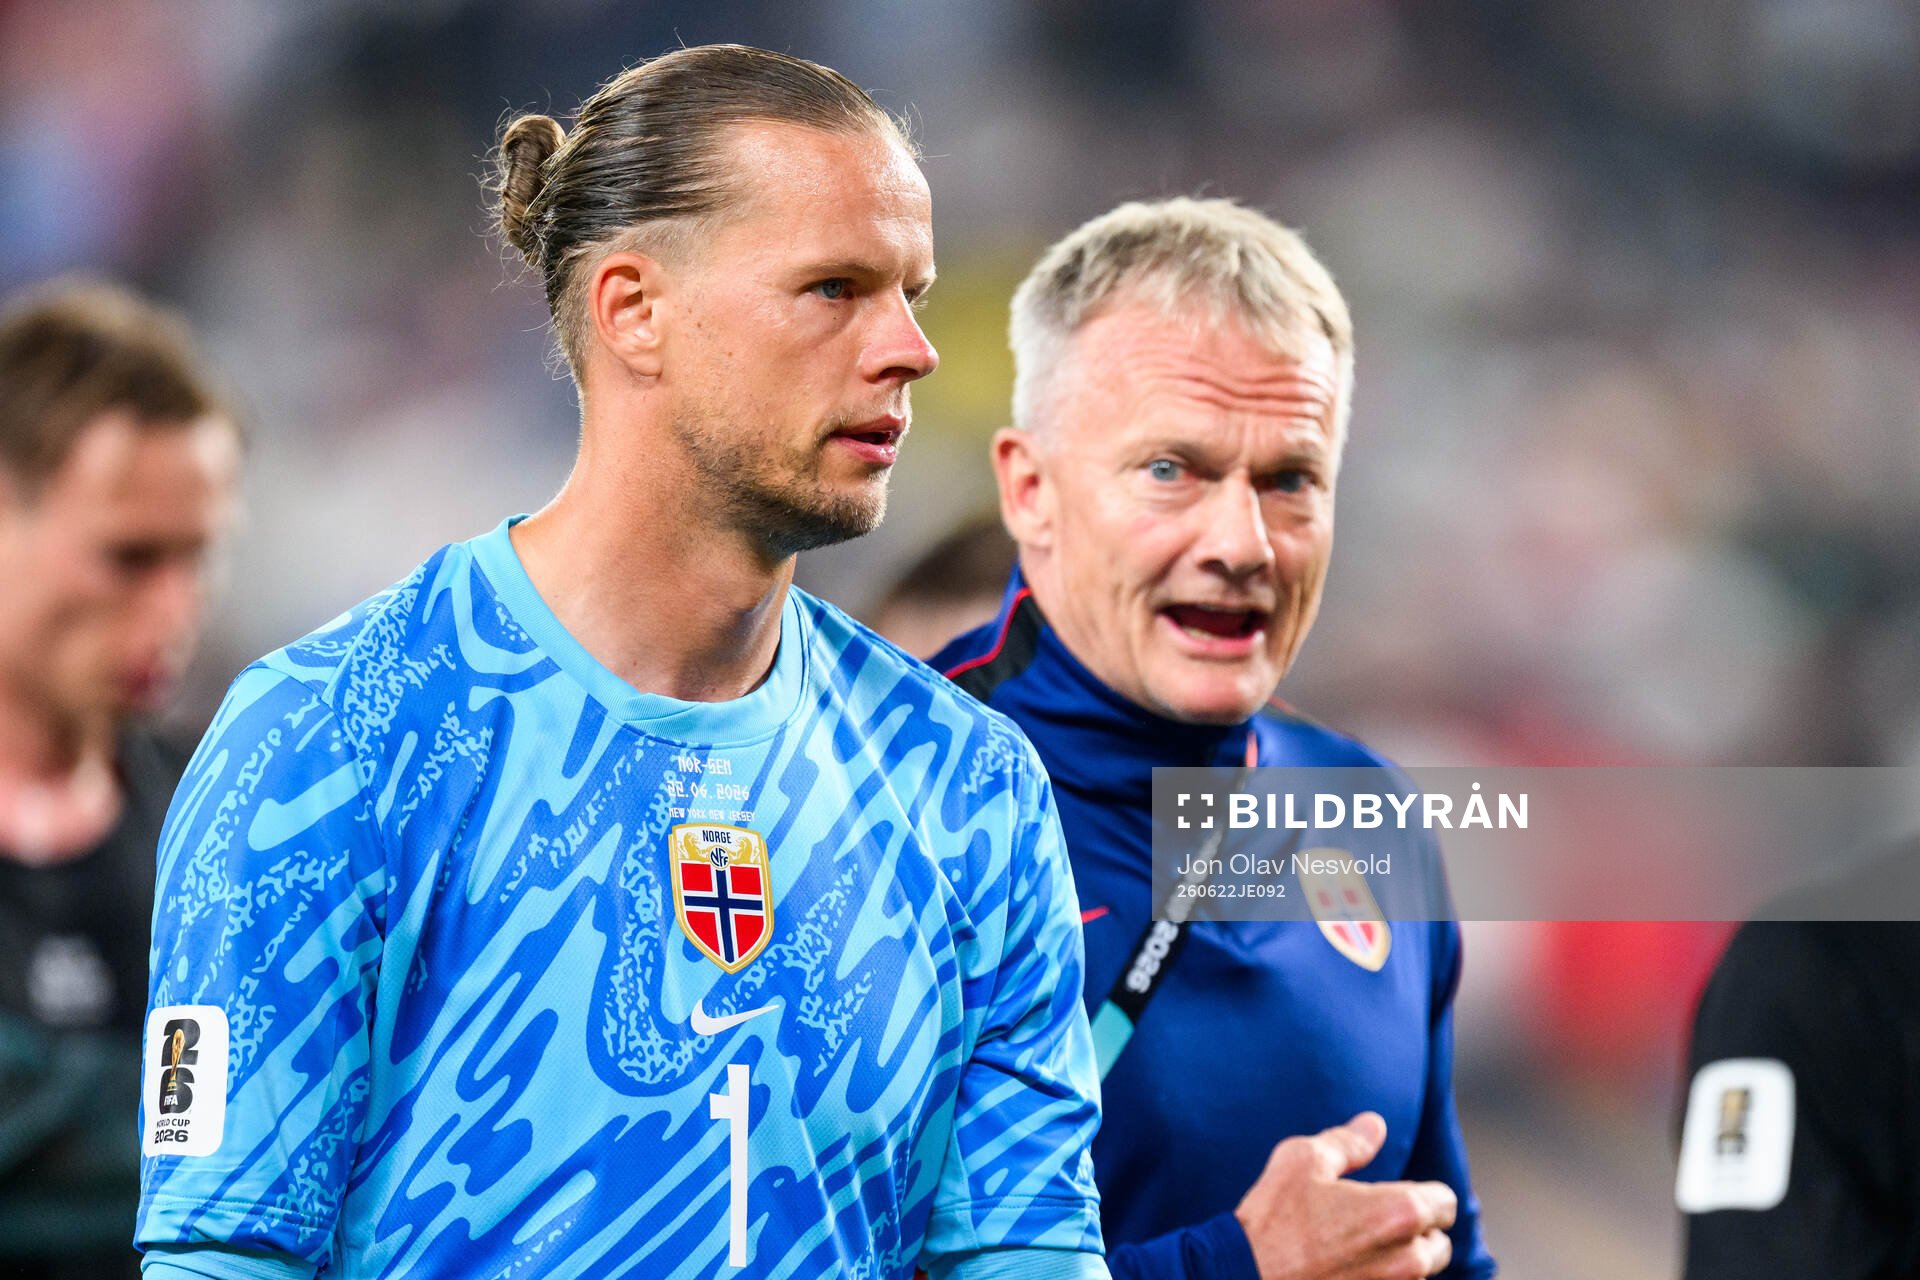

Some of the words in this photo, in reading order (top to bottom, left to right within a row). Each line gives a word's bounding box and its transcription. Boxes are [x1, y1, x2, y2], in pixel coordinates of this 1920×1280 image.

[667, 780, 750, 800] 22.06.2026
[669, 807, 684, 818] NEW
[687, 808, 708, 818] YORK
[709, 809, 724, 819] NEW
[729, 810, 756, 821] JERSEY
[702, 829, 732, 844] NORGE
[164, 1095, 178, 1106] FIFA
[171, 1118, 191, 1127] CUP
[155, 1128, 189, 1144] 2026
[709, 1063, 750, 1268] 1
